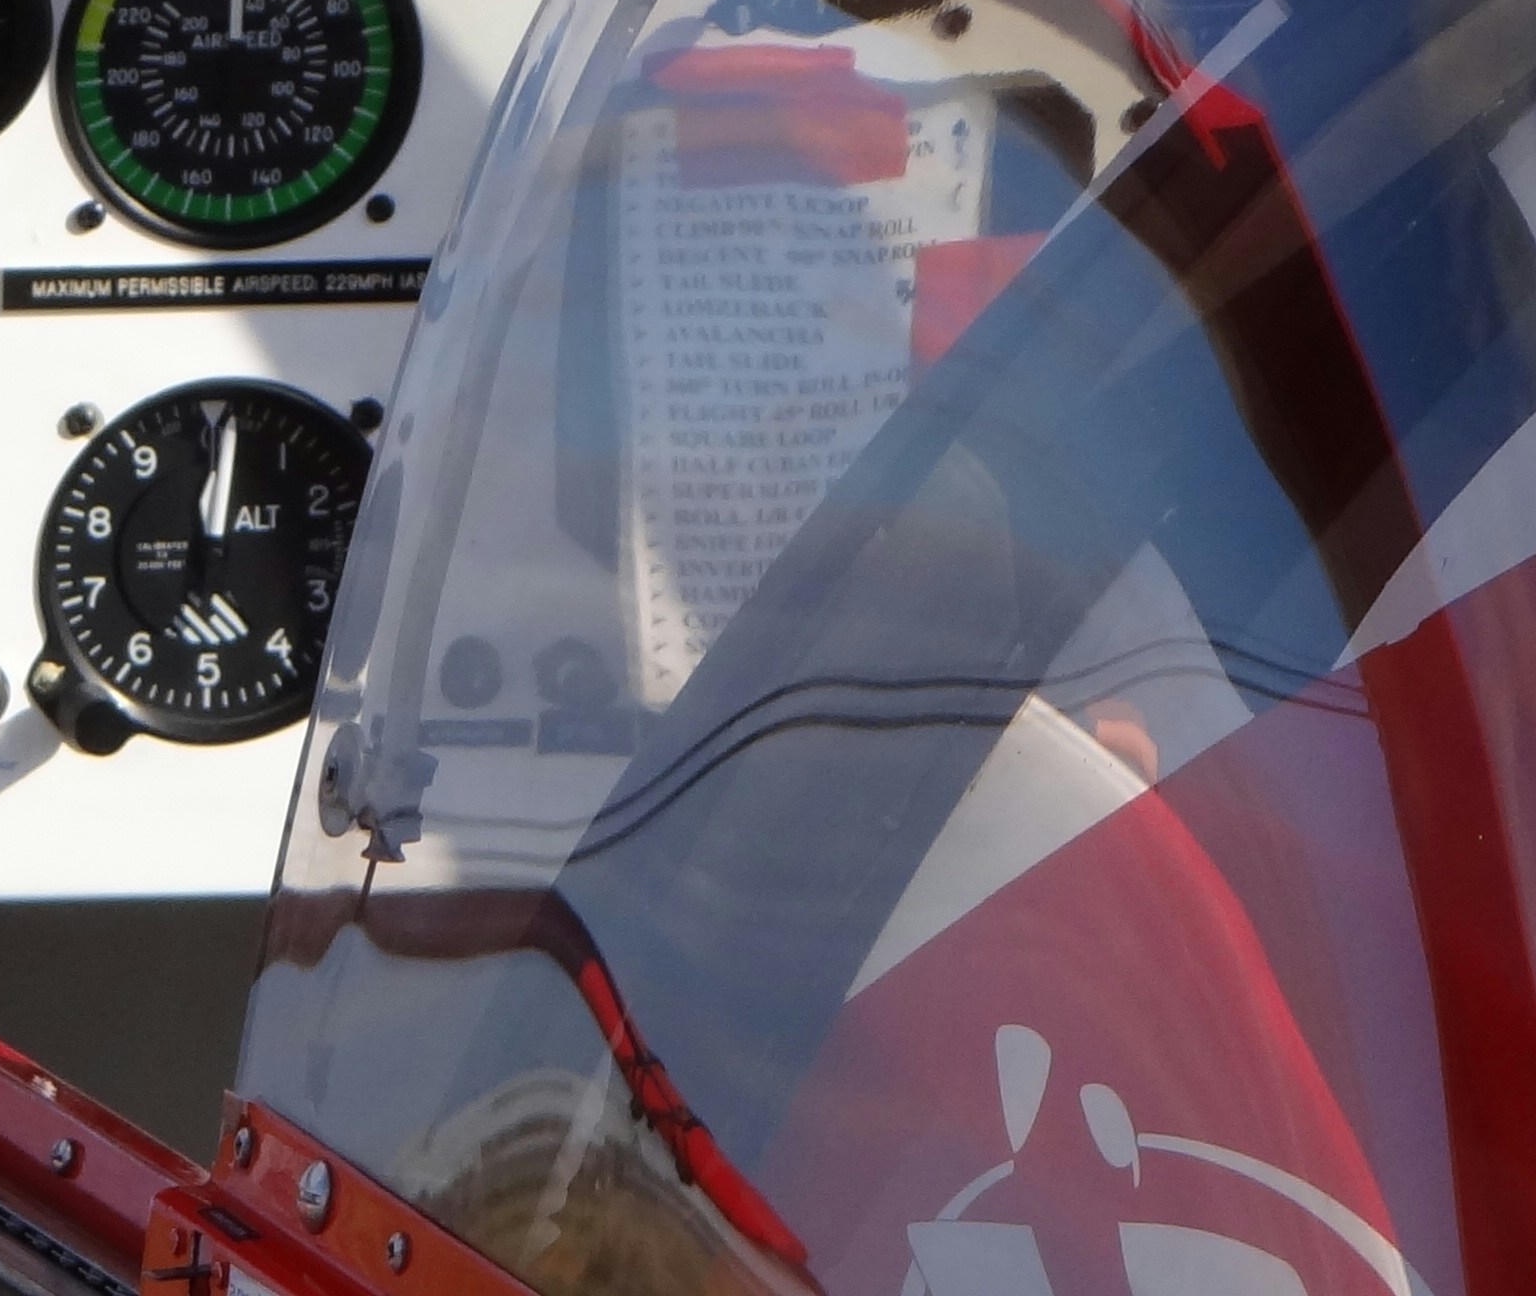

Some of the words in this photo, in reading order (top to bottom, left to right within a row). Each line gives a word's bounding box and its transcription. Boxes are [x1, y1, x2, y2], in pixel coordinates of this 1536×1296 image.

[191, 31, 283, 49] AIREED
[106, 69, 139, 85] 200
[333, 61, 362, 78] 100
[132, 130, 160, 147] 180
[305, 126, 334, 143] 120
[252, 168, 282, 184] 140
[30, 278, 112, 300] MAXIMUM
[117, 275, 225, 298] PERMISSIBLE
[133, 445, 158, 480] 9
[279, 441, 287, 472] 1
[307, 483, 331, 518] 2
[87, 506, 112, 539] 8
[234, 503, 281, 533] ALT
[82, 576, 107, 610] 7
[306, 578, 331, 614] 3
[127, 632, 154, 666] 6
[265, 627, 292, 659] 4
[196, 652, 222, 686] 5
